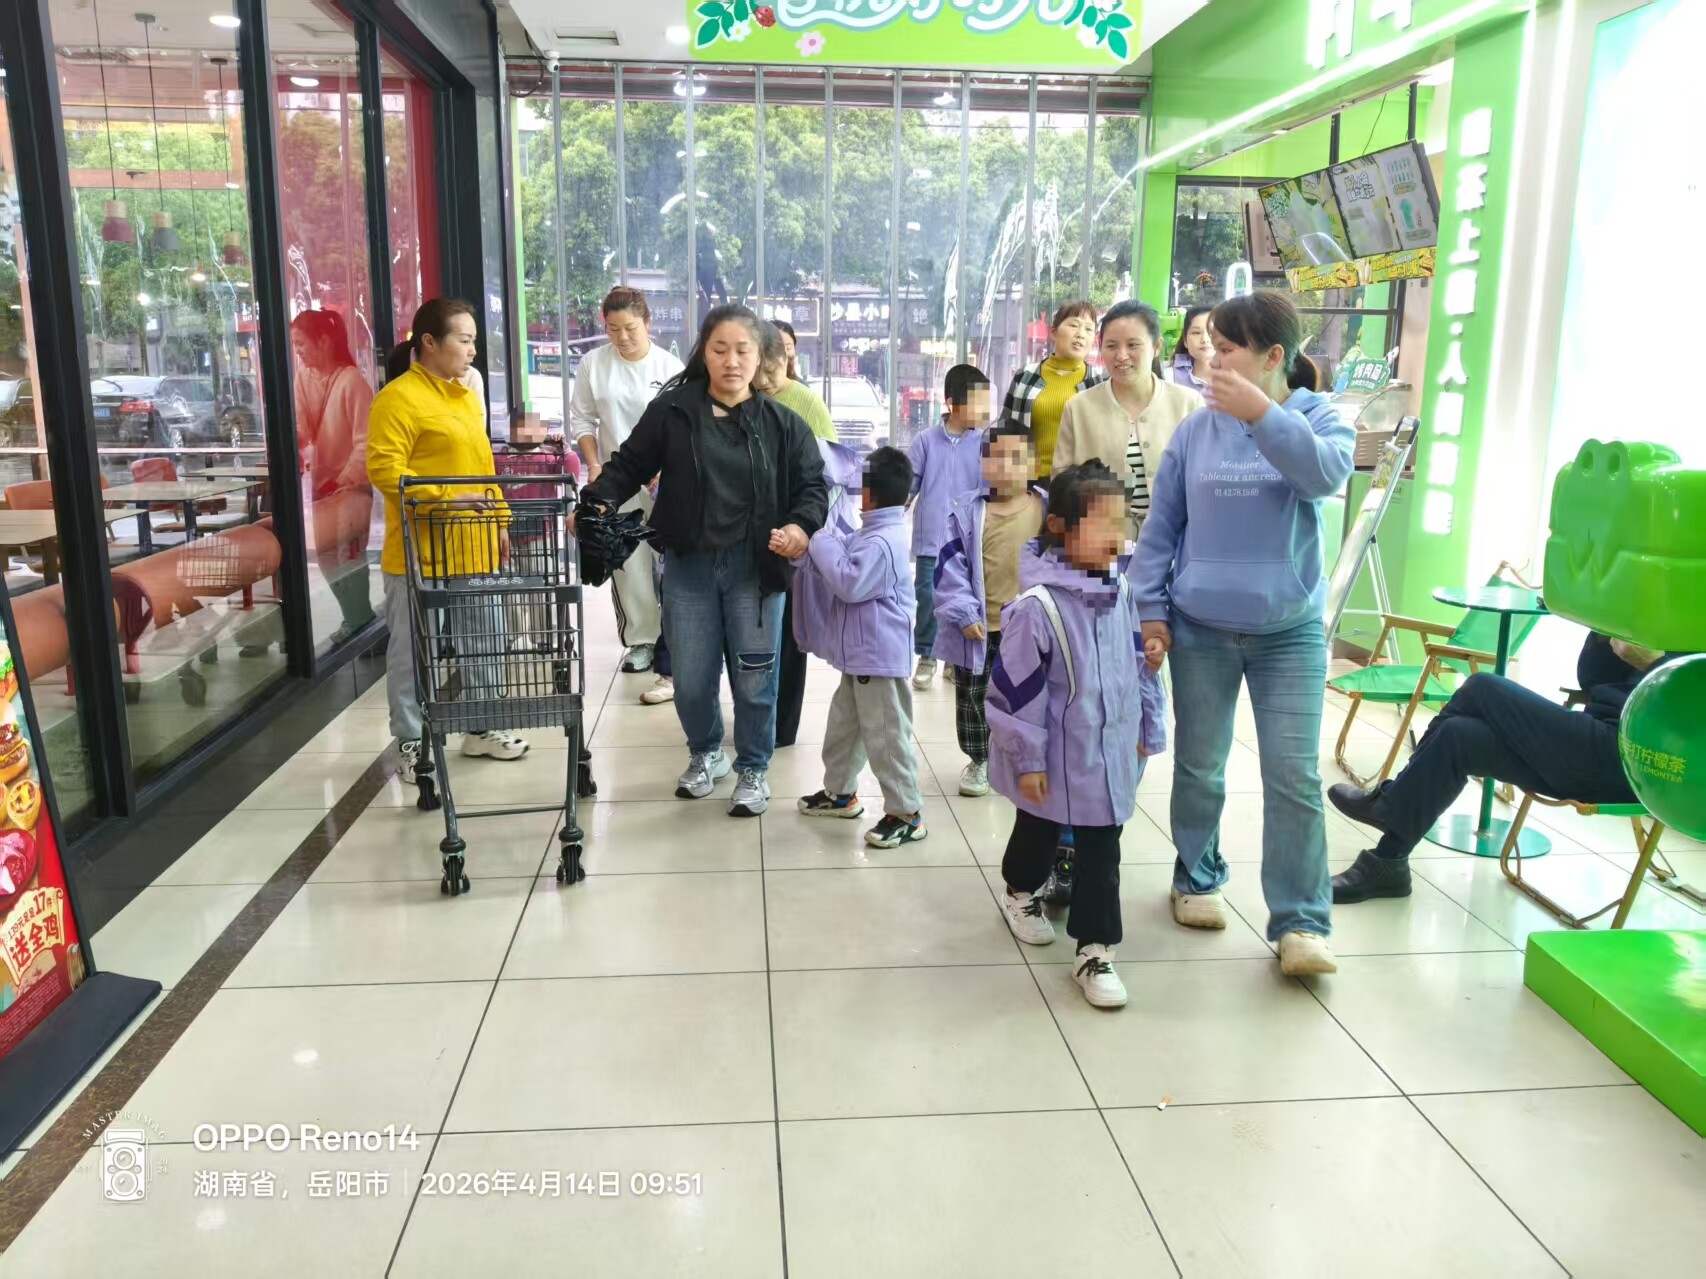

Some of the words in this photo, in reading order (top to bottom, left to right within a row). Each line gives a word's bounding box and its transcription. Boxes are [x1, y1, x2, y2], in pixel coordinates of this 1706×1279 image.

[649, 306, 683, 322] 炸串
[10, 912, 59, 972] 送全鸡
